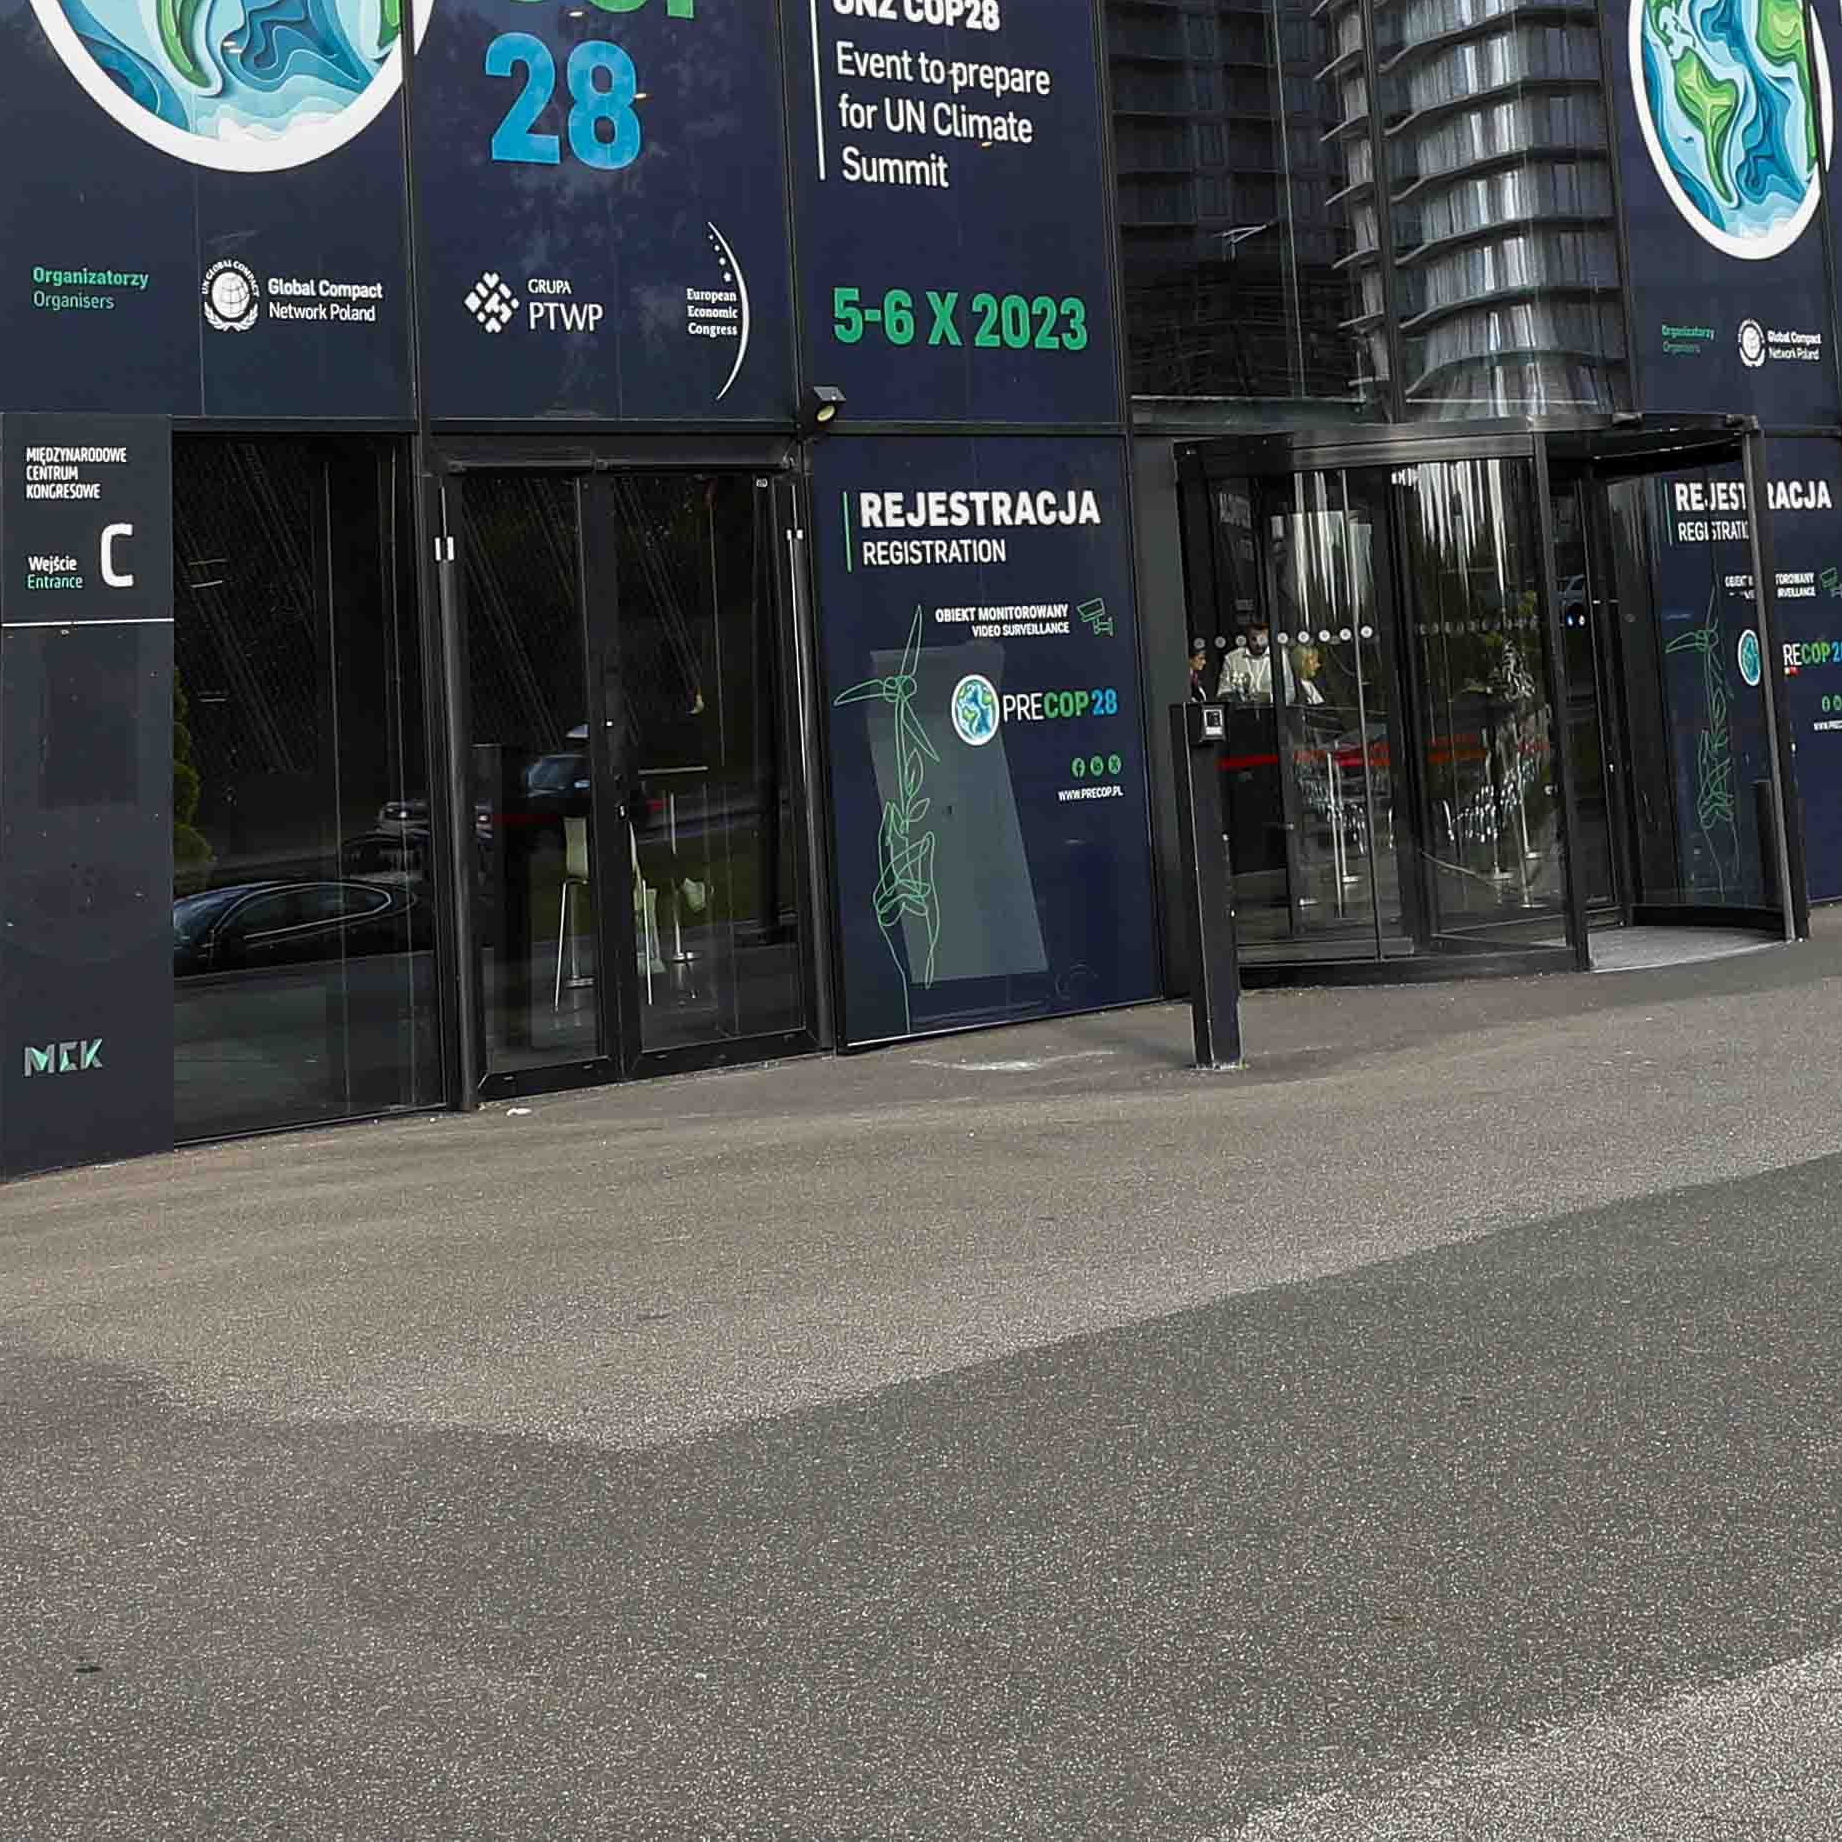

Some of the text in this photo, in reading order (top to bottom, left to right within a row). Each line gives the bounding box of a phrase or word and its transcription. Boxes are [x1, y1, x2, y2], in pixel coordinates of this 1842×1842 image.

[836, 40, 1051, 98] Event to prepare
[484, 32, 644, 171] 28
[839, 93, 1033, 143] for UN Climate
[842, 146, 950, 188] Summit
[32, 267, 149, 290] Organizatorzy
[268, 277, 383, 301] Global Compact
[528, 278, 572, 295] GRUPA
[33, 290, 115, 311] Organisers
[686, 288, 737, 303] European
[269, 301, 376, 322] Network Poland
[529, 301, 604, 332] PTWP
[687, 305, 738, 320] Economic
[832, 286, 1088, 351] 5-6 X 2023
[688, 322, 738, 338] Congress
[26, 447, 127, 465] MIĘDZYNARODOWE
[26, 465, 78, 480] CENTRUM
[26, 483, 101, 499] KONGRESOWE
[860, 490, 1101, 528] REJESTRACJA
[101, 523, 134, 588] C
[862, 539, 1006, 566] REGISTRATION
[28, 555, 77, 574] Wejście
[28, 574, 83, 589] Entrance
[935, 604, 1068, 623] OBIEKT MONITOROWANY
[972, 622, 1070, 638] VIDEO SURVEILLANCE
[1058, 785, 1123, 802] WWW.PRECOP.PL
